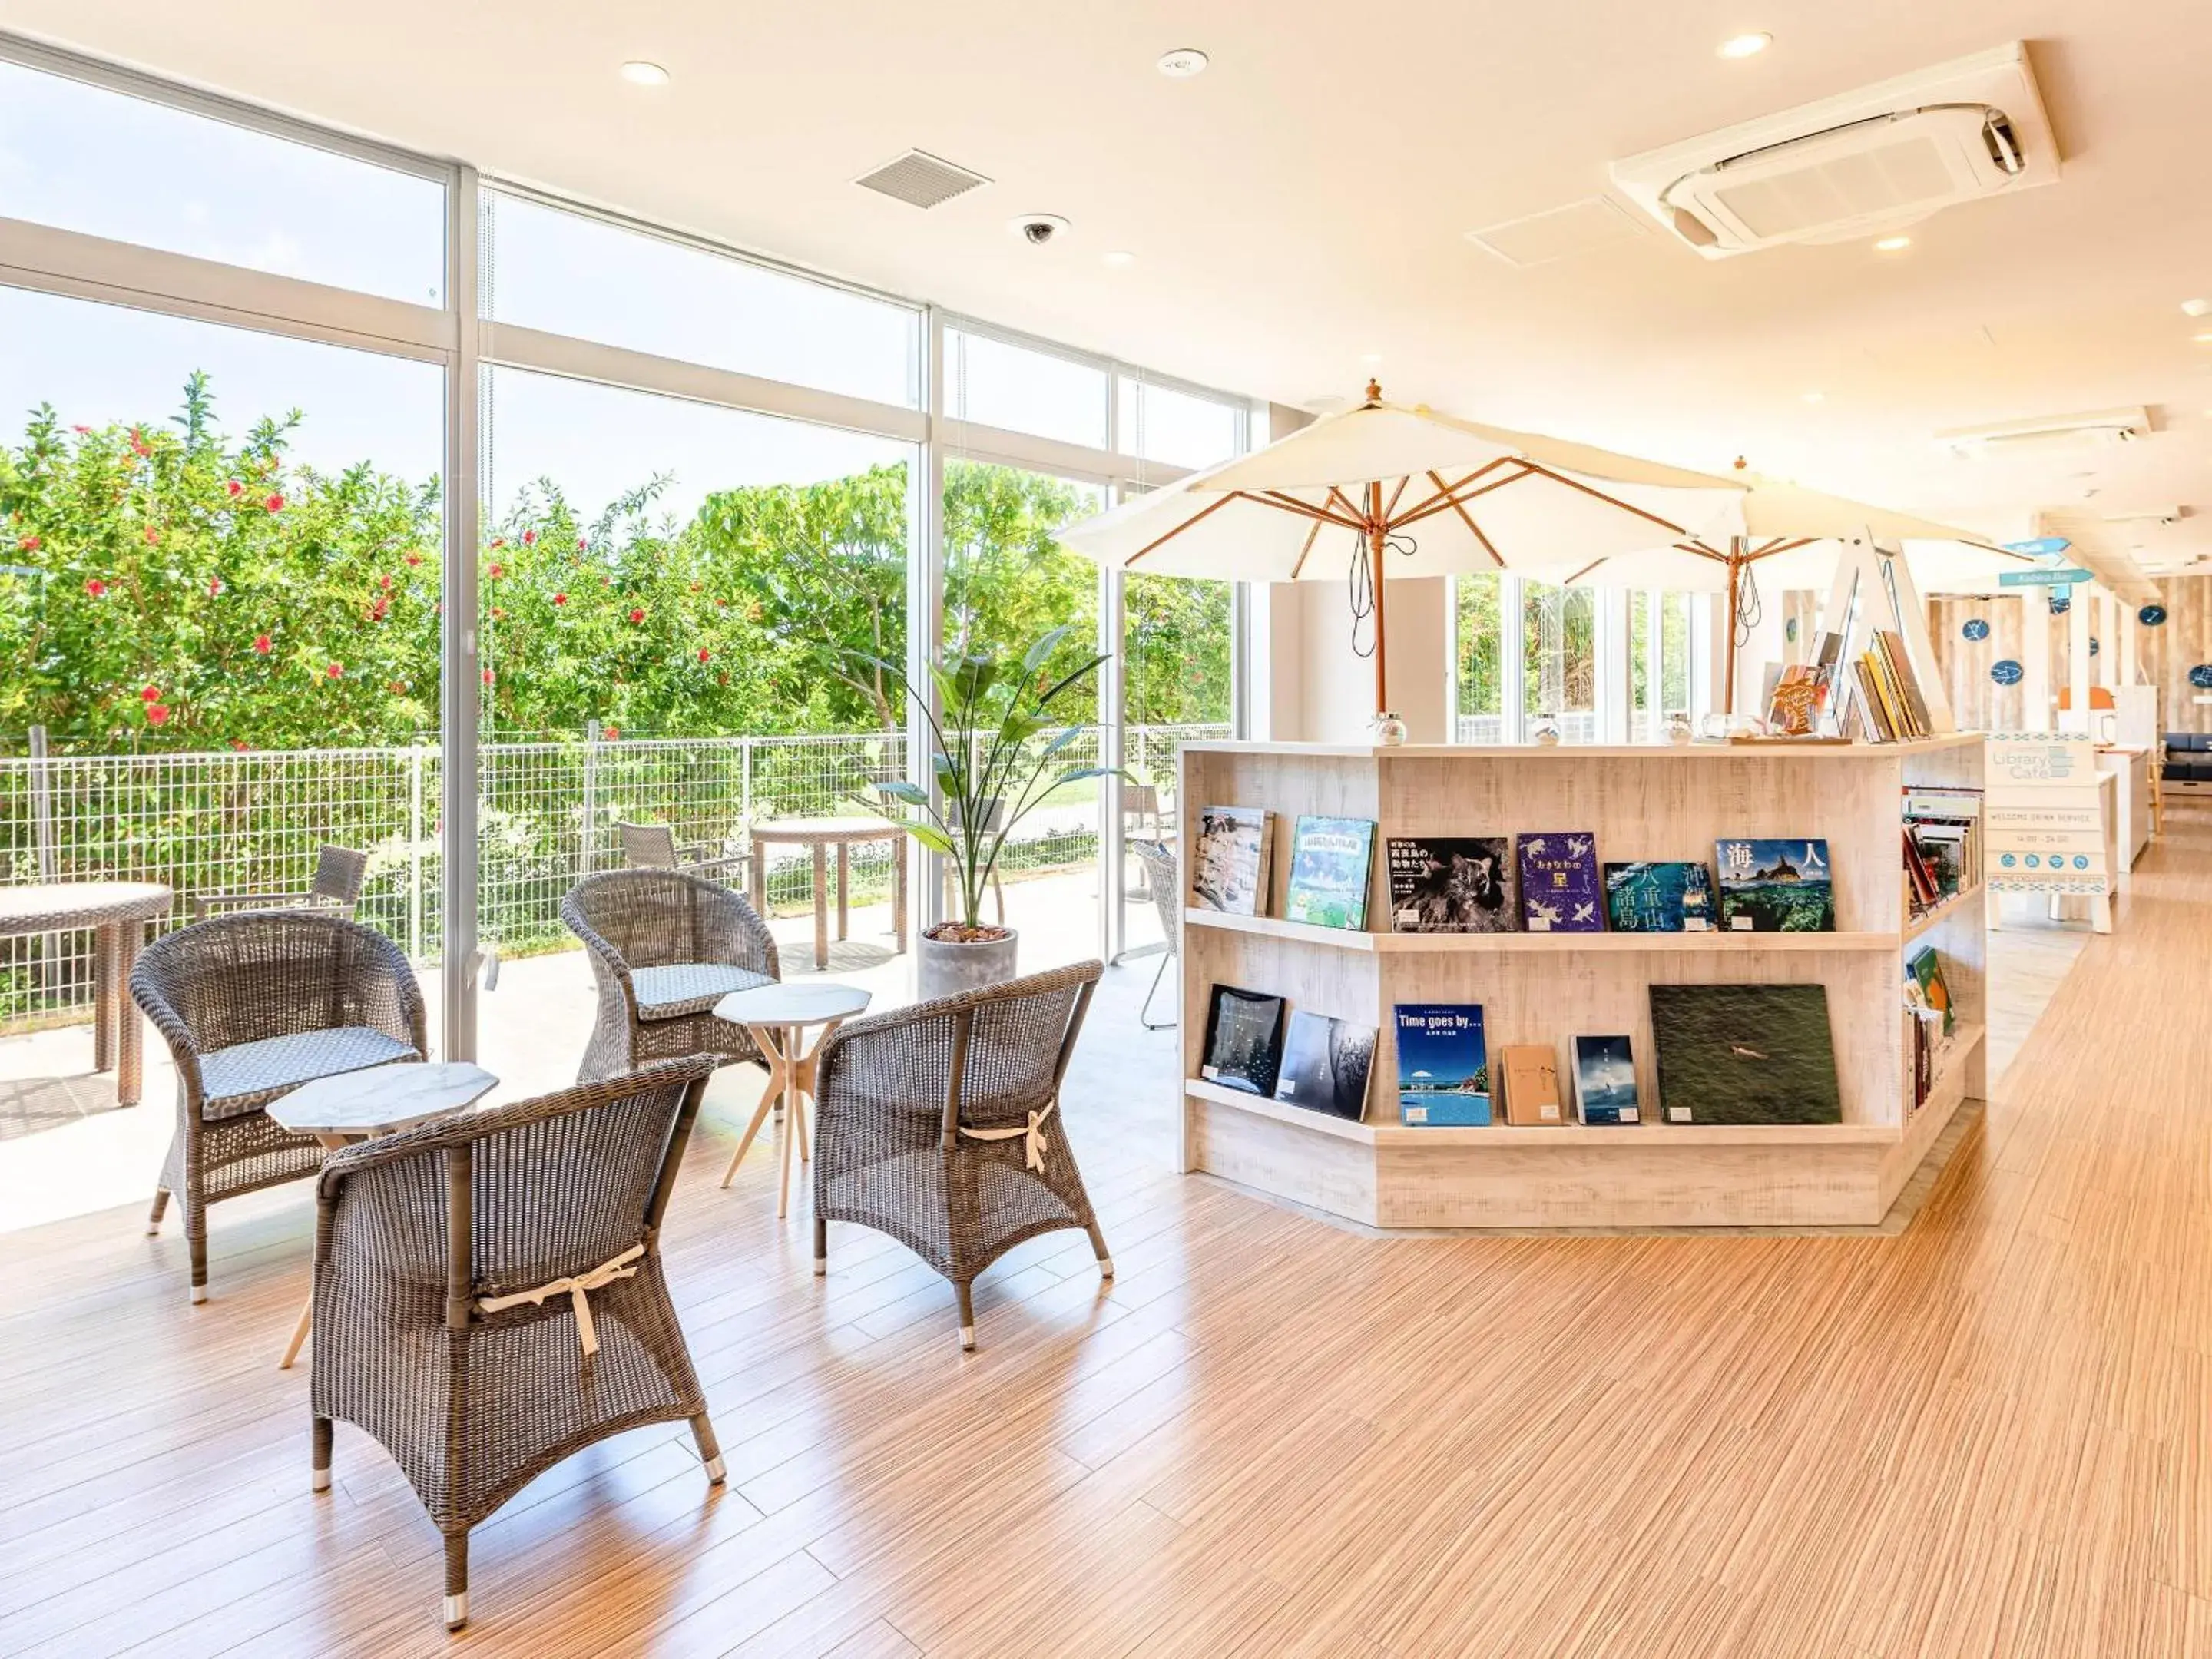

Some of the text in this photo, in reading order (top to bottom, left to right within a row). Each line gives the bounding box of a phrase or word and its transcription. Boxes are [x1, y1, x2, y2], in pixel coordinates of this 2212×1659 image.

[1992, 752, 2048, 767] Library
[1552, 872, 1569, 888] 星
[1399, 1014, 1426, 1028] Time
[1428, 1015, 1454, 1029] goes
